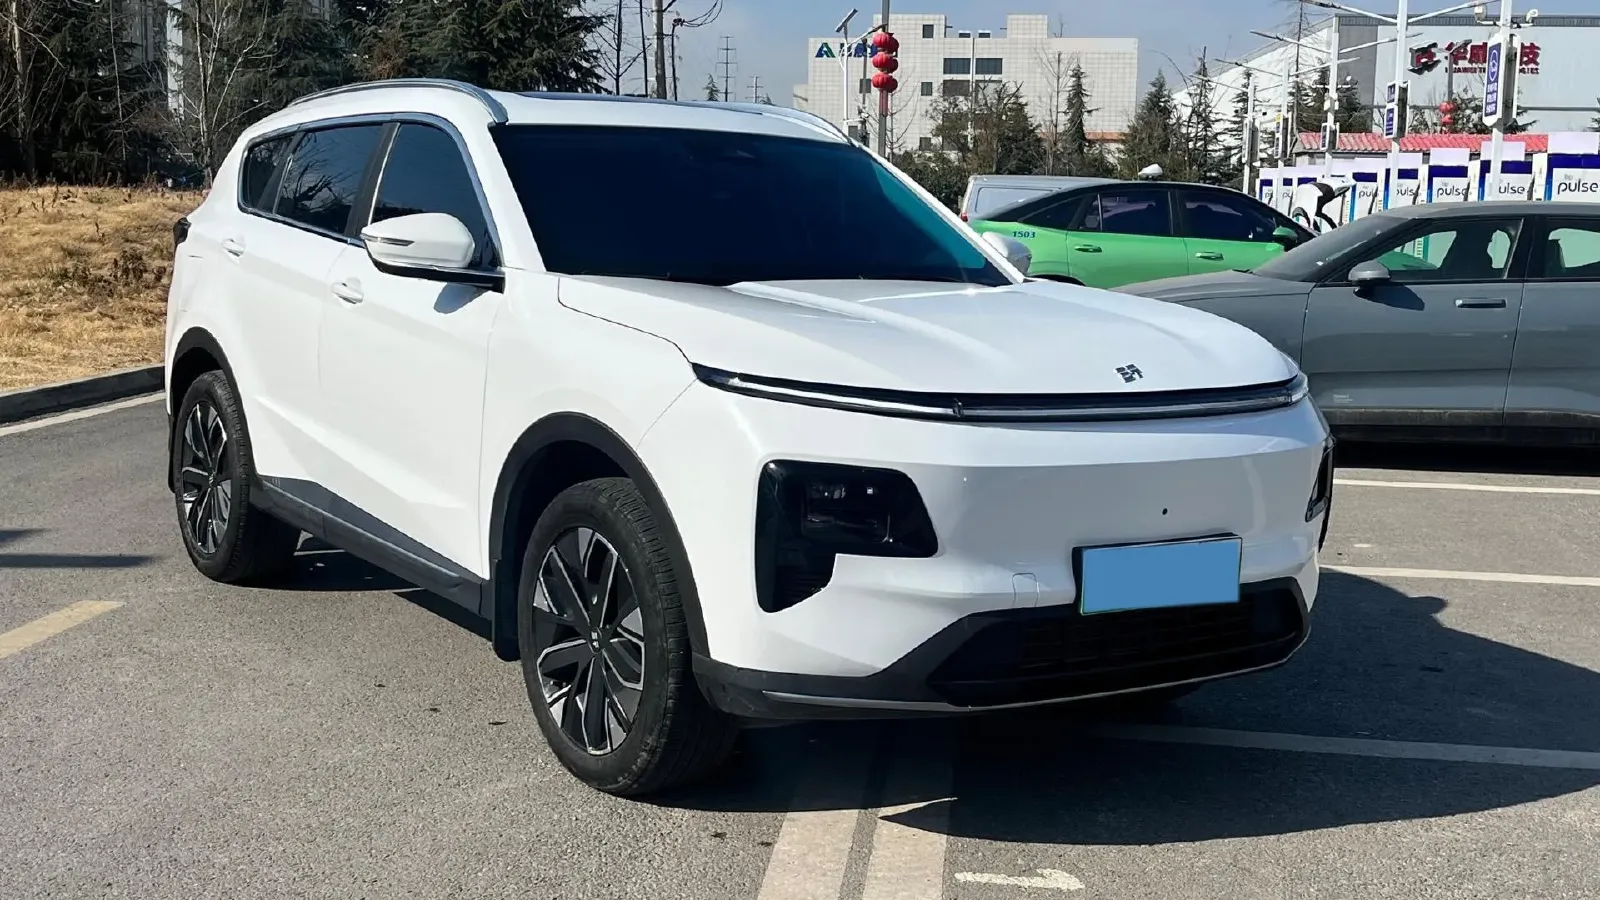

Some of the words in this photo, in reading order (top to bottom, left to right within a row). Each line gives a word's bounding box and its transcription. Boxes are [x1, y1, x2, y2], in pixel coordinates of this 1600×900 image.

[1498, 182, 1525, 194] ulse
[1557, 178, 1599, 195] pulse
[1012, 231, 1036, 239] 1503
